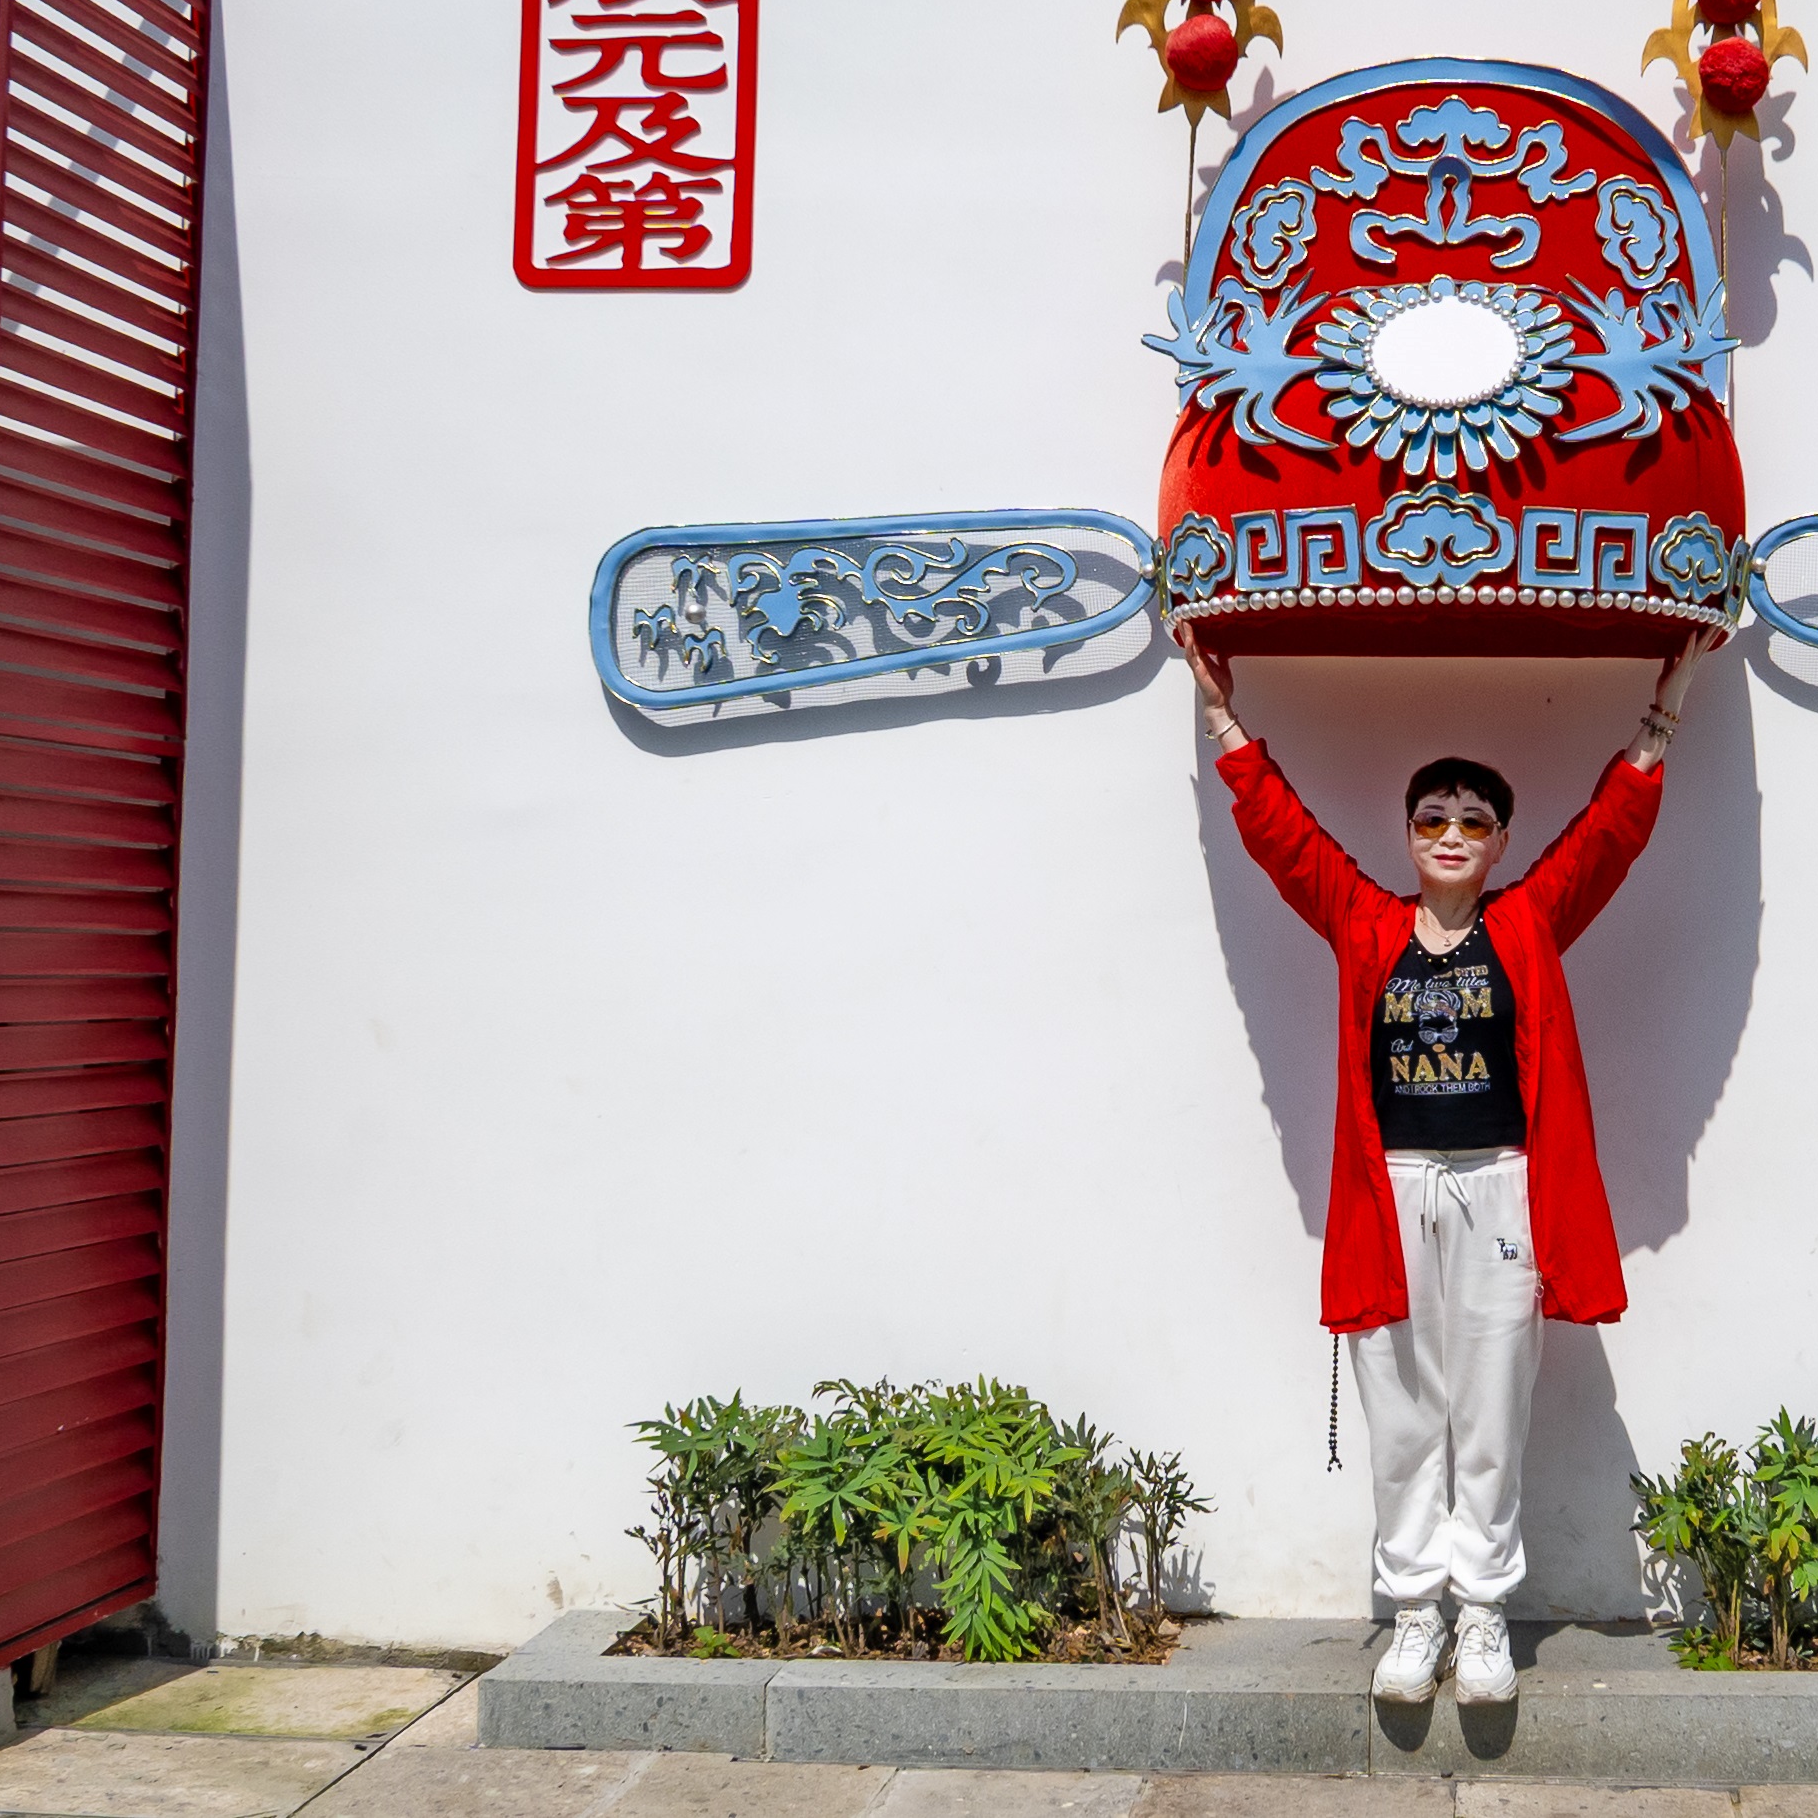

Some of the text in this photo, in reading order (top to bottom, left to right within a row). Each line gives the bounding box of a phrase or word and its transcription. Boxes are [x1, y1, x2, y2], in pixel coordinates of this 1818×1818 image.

[1390, 1051, 1491, 1082] NANA
[1394, 1084, 1411, 1094] AND
[1414, 1083, 1438, 1094] ROCK
[1442, 1083, 1466, 1093] THEM
[1467, 1081, 1491, 1092] BOTH
